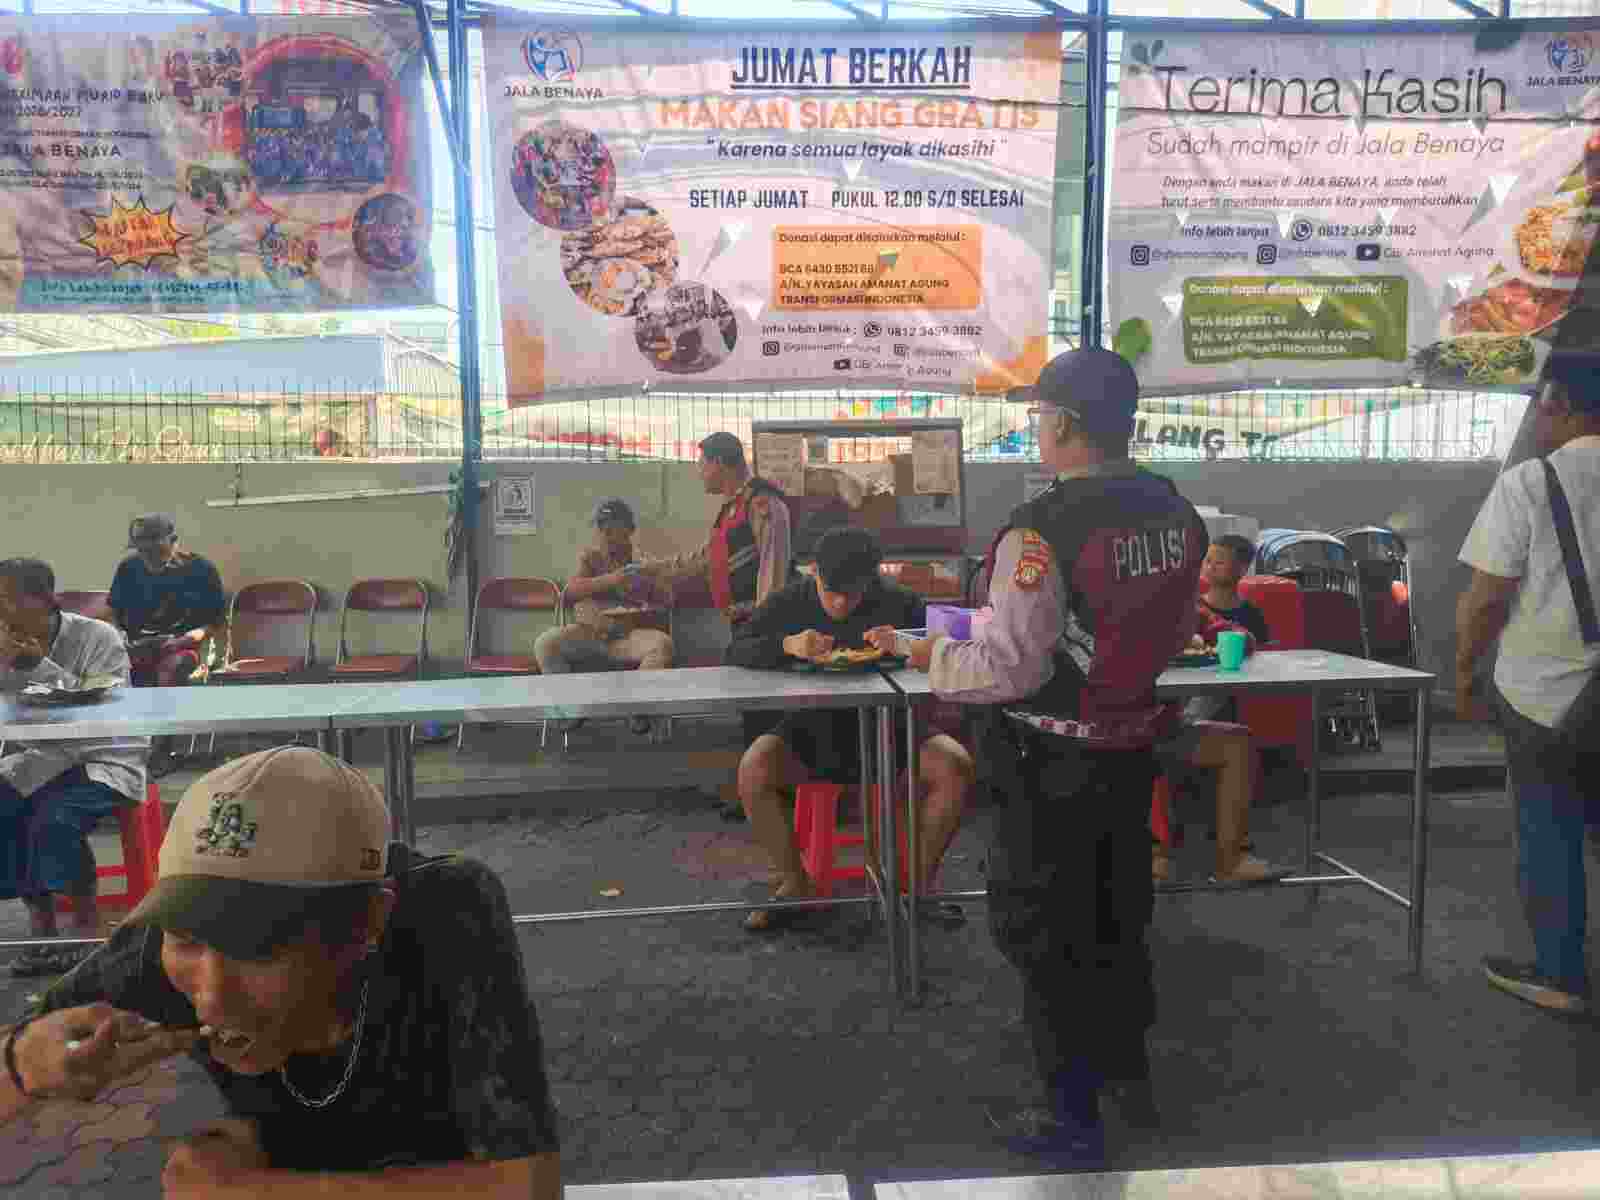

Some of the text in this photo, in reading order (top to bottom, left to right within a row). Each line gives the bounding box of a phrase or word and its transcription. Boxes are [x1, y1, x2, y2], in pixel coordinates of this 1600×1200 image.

[732, 46, 971, 84] JUMAT BERKAH
[504, 85, 604, 98] JALA BENAYA
[1153, 65, 1506, 115] Terima Kasih
[660, 99, 1041, 128] MAKAN SIANG GRATIS
[50, 143, 121, 158] BENAYA
[791, 144, 857, 158] semua
[862, 140, 914, 161] layak
[1147, 130, 1505, 161] Sudah mampir di Jala Benaya
[1295, 176, 1325, 187] JALA
[690, 189, 1024, 208] SETIAP JUMAT PUKUL 12.00 S/D SELESAI
[1182, 225, 1204, 238] Info
[1206, 224, 1234, 237] lebih
[806, 279, 859, 290] YAYASAN
[861, 279, 907, 289] AMANAT
[909, 279, 951, 289] AGUNG
[1111, 527, 1186, 581] POLISI
